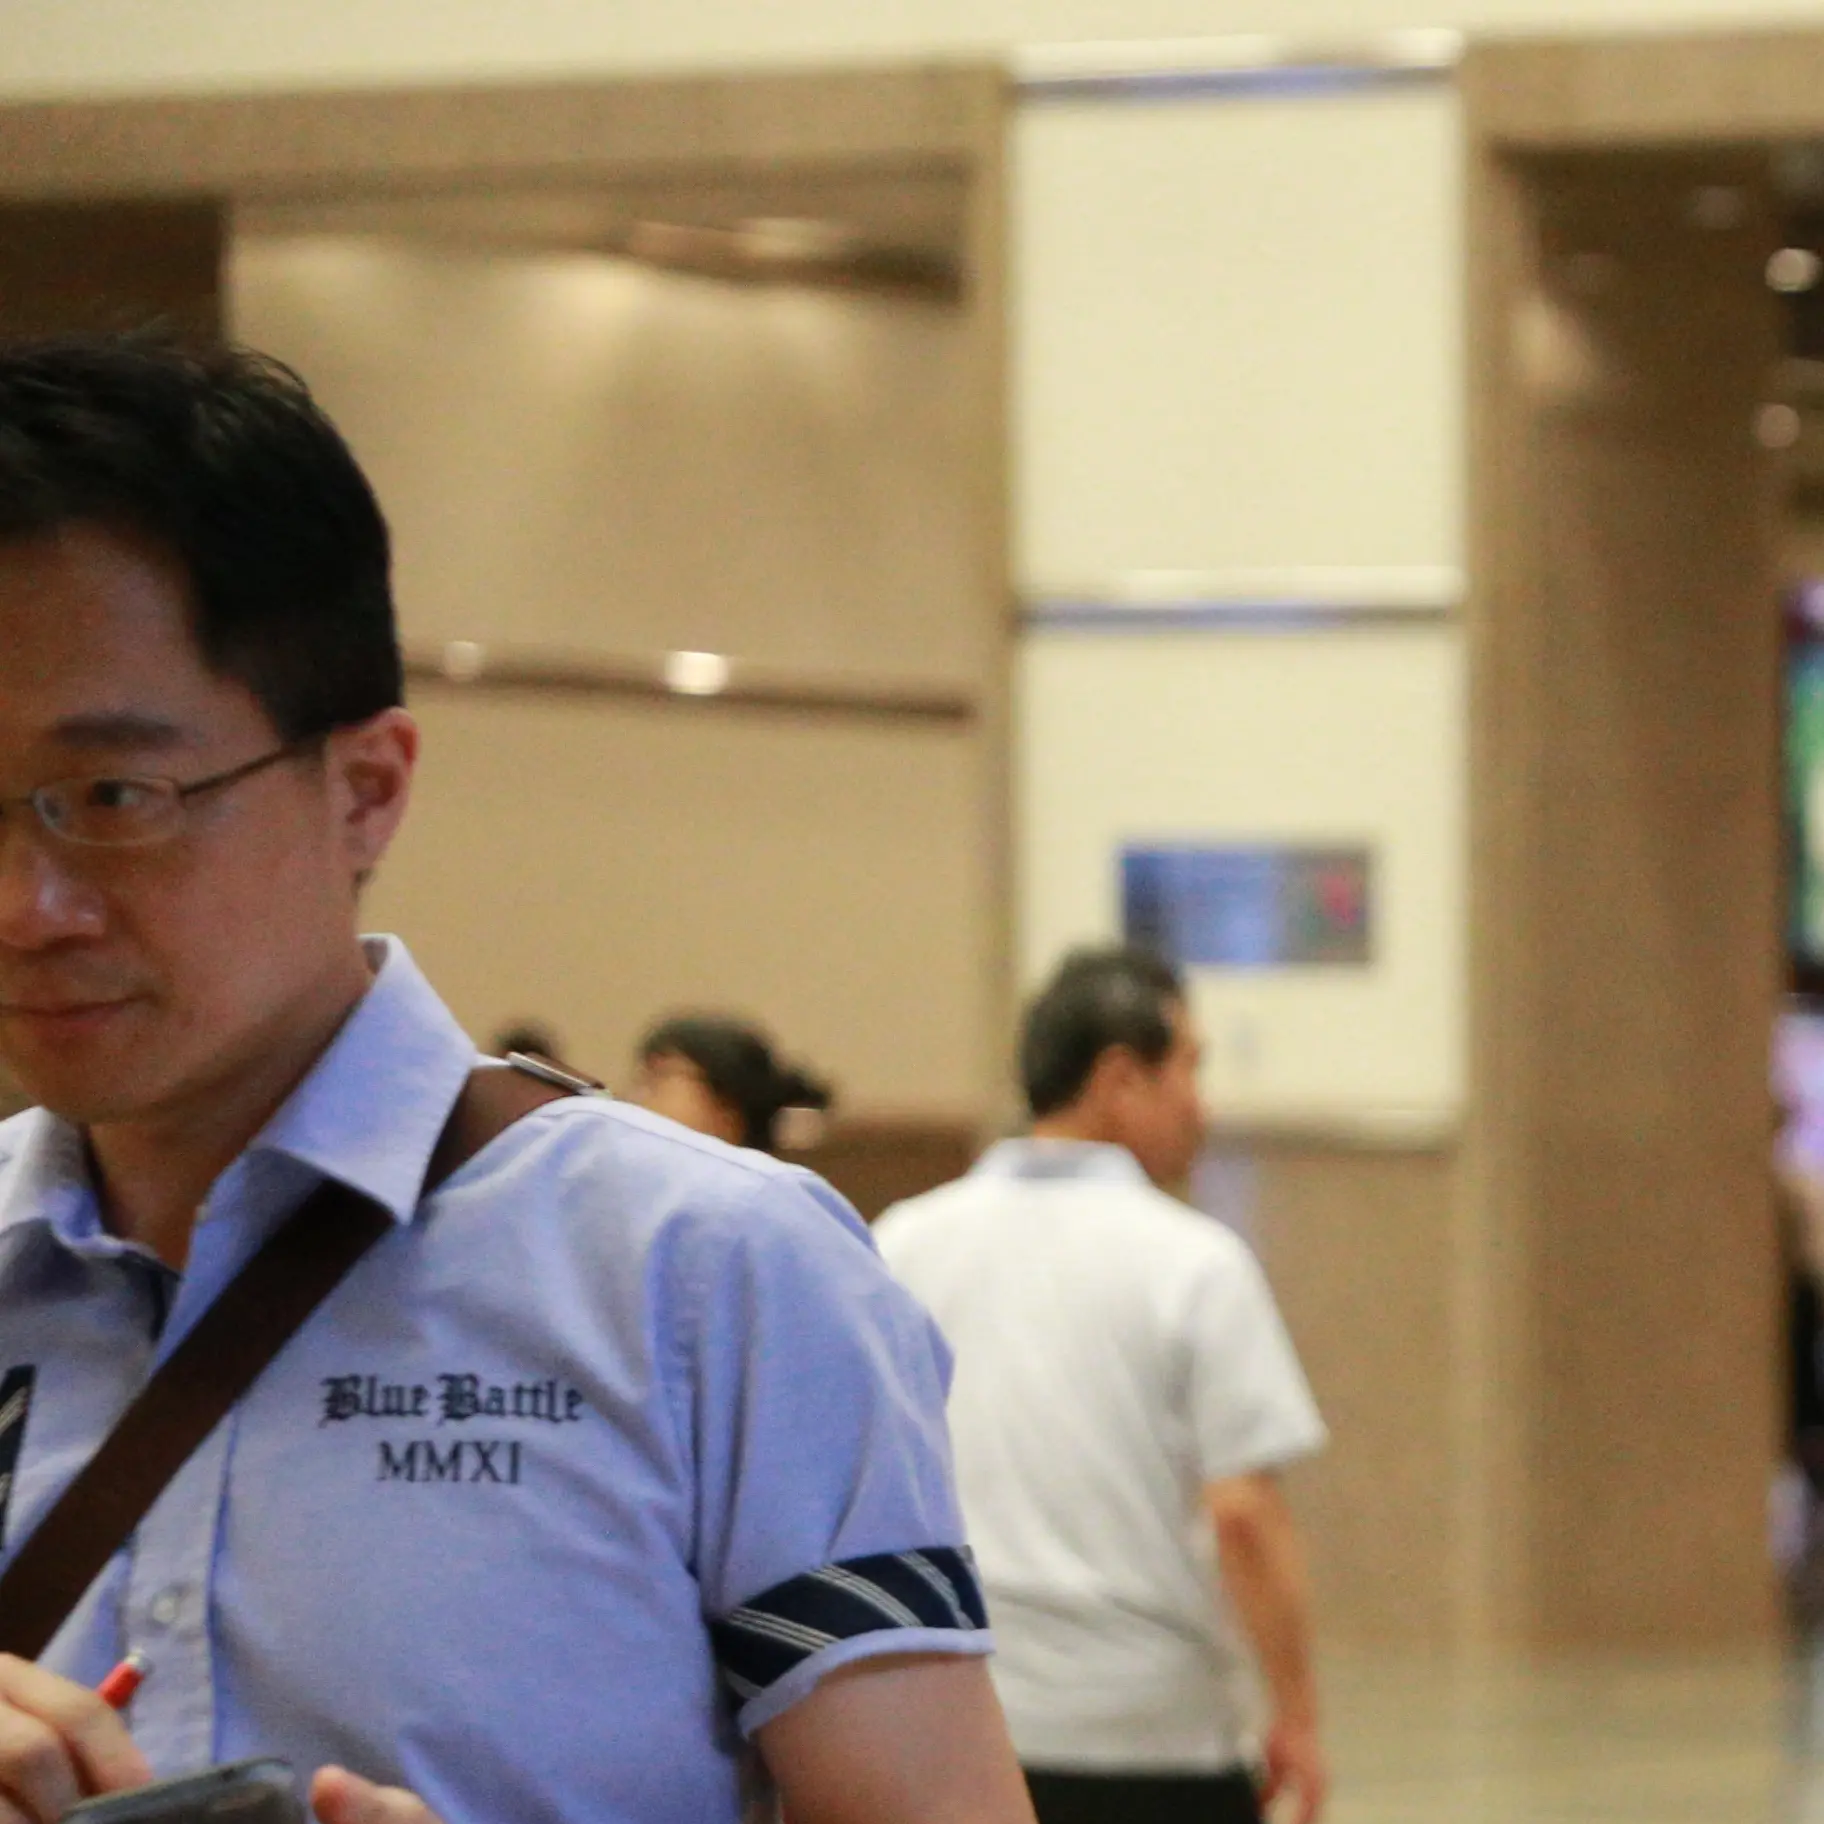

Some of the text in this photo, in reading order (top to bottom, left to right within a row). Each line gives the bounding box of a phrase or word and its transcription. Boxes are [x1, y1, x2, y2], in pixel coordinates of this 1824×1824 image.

[320, 1373, 583, 1427] Blue Battle
[377, 1440, 521, 1484] MMXI
